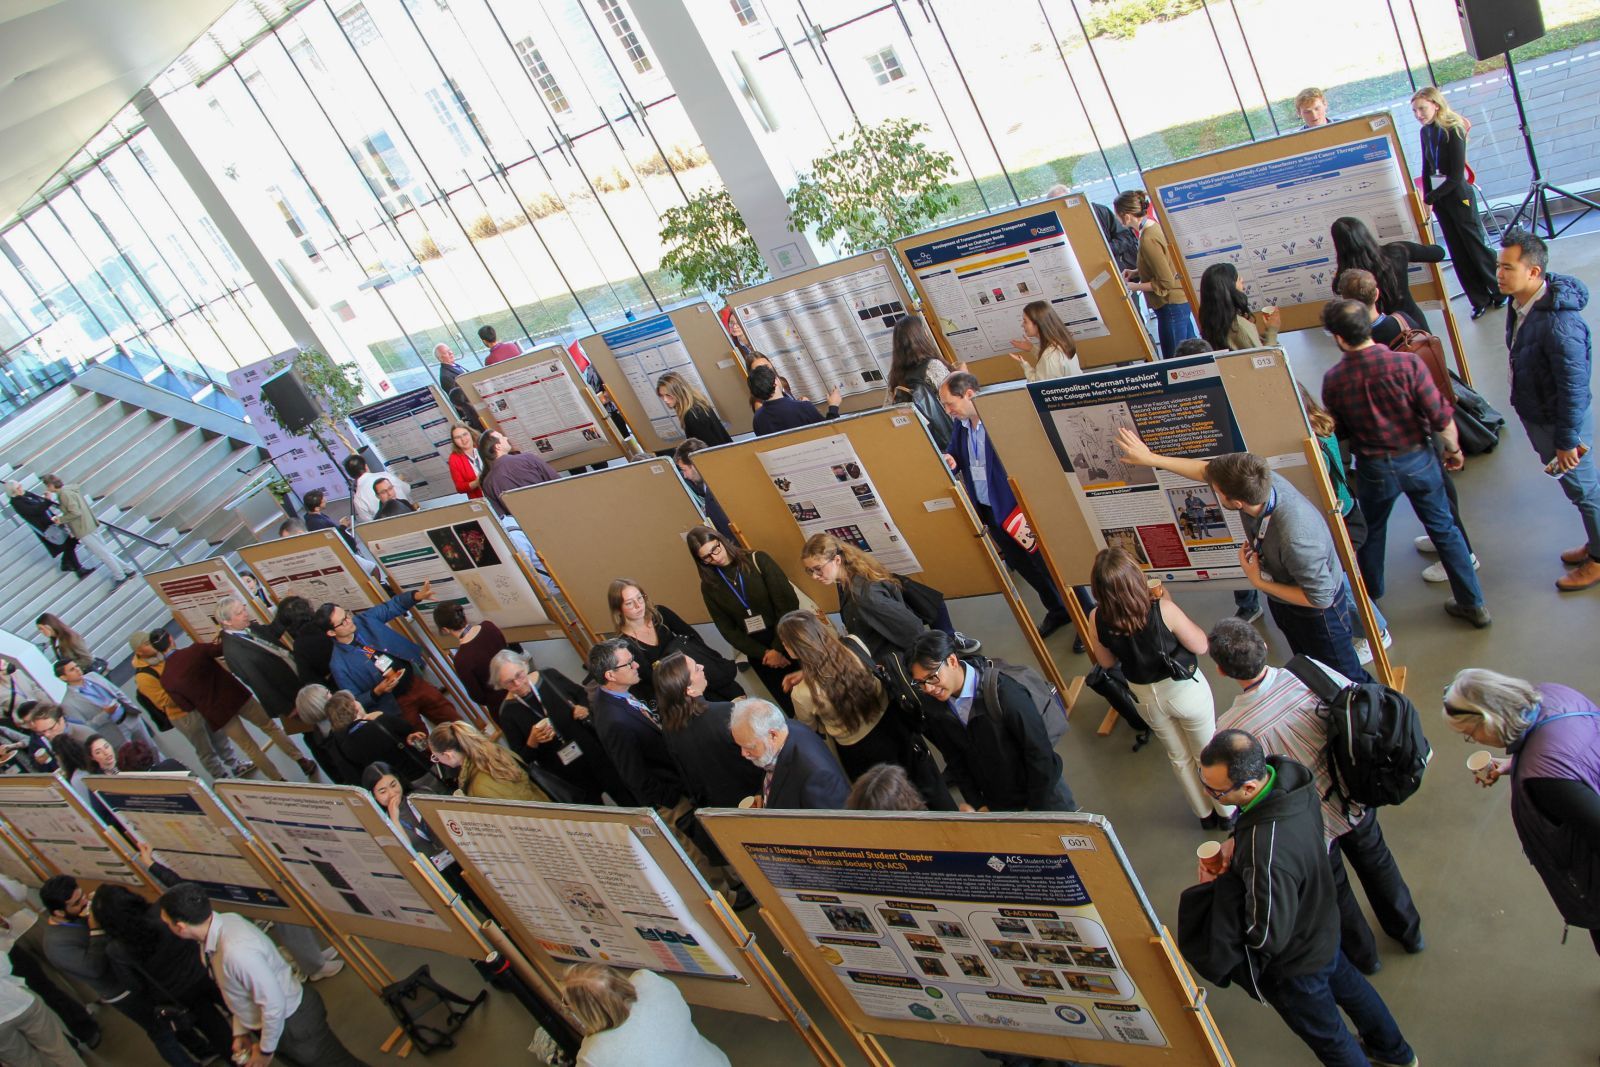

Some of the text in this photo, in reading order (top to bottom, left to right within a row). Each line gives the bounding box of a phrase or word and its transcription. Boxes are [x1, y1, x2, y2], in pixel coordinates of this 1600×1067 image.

[1336, 143, 1368, 155] Therapeutics
[1001, 222, 1026, 233] Transporters
[1041, 372, 1159, 396] Cosmopolitan "German Fashion"
[1064, 391, 1091, 400] Cologne
[1092, 388, 1112, 397] Men's
[1112, 383, 1140, 394] Fashion
[1141, 380, 1163, 390] Week
[745, 845, 933, 862] Queen's University International Student Chapter
[771, 855, 806, 864] American
[806, 856, 842, 866] Chemical
[843, 859, 872, 869] Society
[874, 861, 908, 871] (Q-ACS)
[1006, 855, 1023, 864] ACS
[1046, 857, 1069, 866] Chapter
[910, 903, 934, 911] Awards
[1004, 910, 1028, 918] Q-ACS
